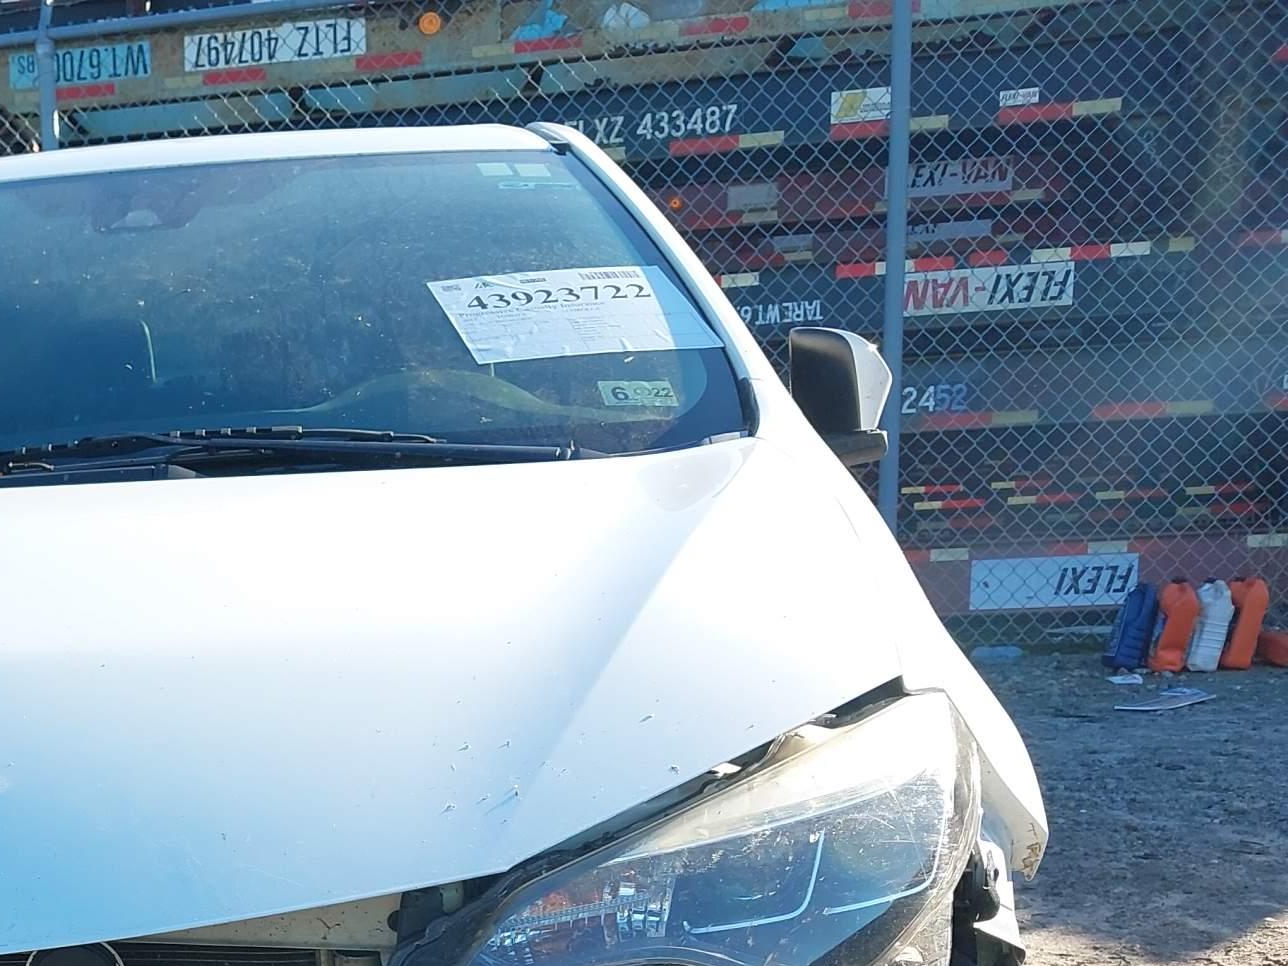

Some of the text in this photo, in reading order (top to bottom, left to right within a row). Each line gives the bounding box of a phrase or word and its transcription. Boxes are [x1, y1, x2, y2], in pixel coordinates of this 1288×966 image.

[195, 30, 279, 69] 407497
[636, 104, 738, 140] 433487
[907, 158, 1011, 188] EXI-VAN
[467, 284, 652, 310] 43923722
[1054, 564, 1135, 596] FLEXI
